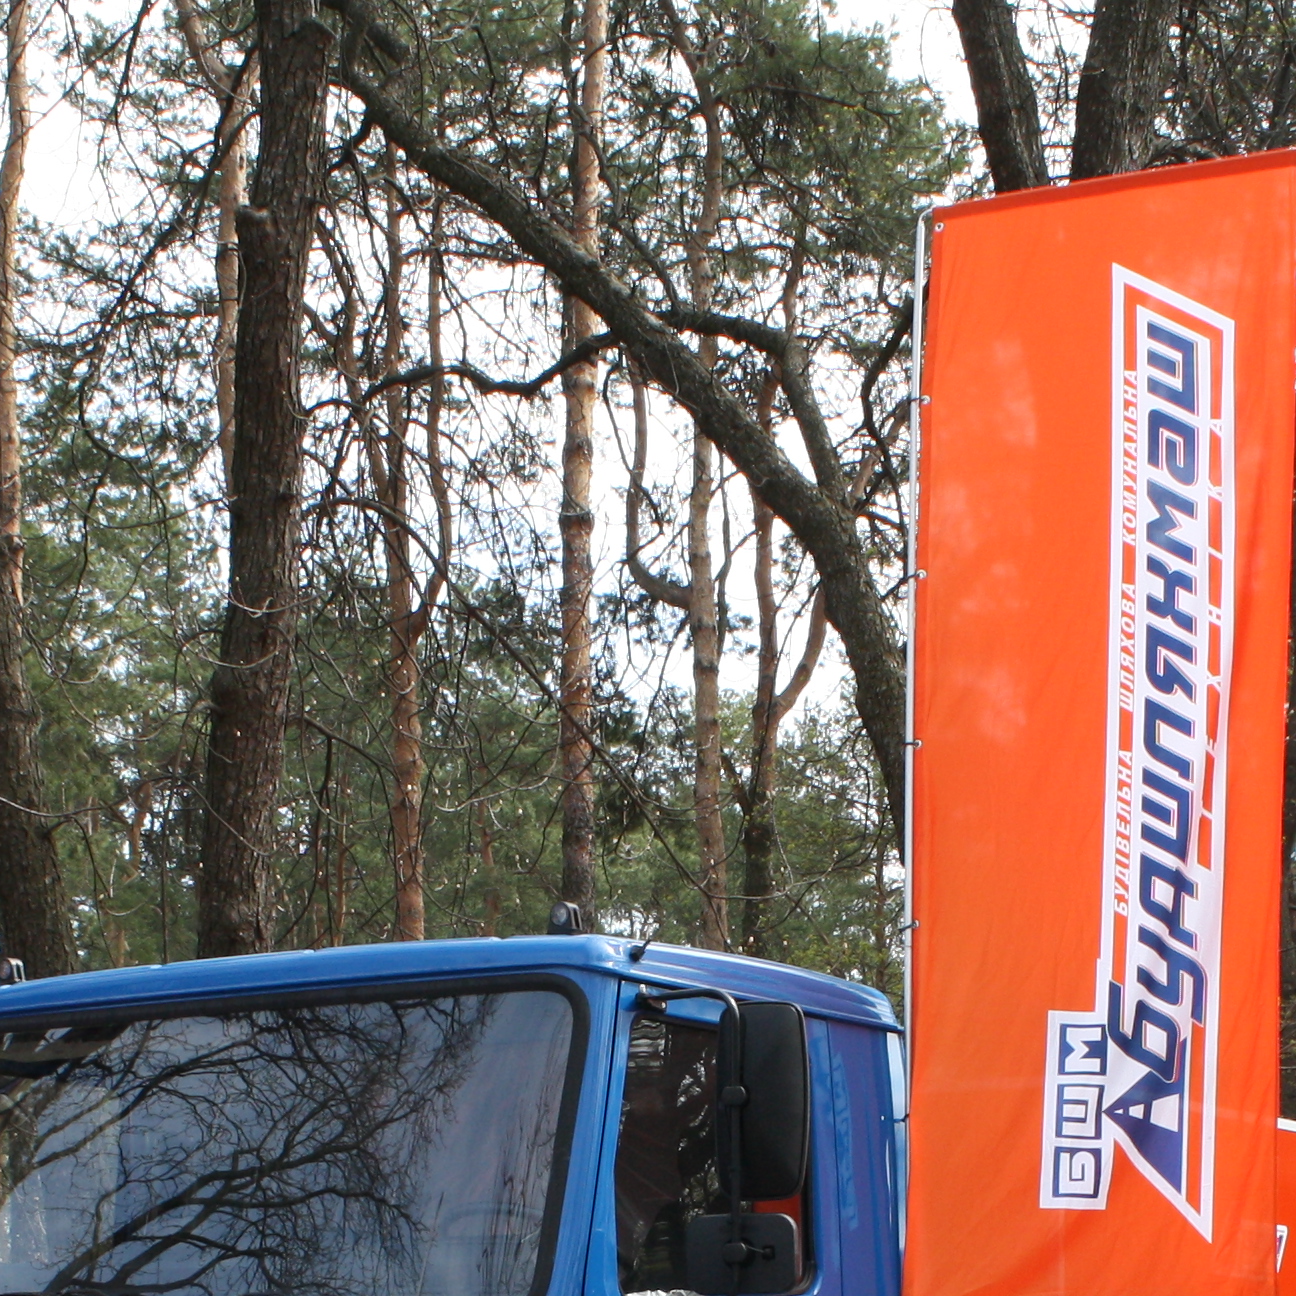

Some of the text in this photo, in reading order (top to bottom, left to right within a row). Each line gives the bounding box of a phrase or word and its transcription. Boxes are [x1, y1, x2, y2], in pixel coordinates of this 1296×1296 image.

[1113, 369, 1138, 917] БУДІВЕЛЬНА ШЛЯХОВА КОМУНАЛЬНА
[1055, 1025, 1105, 1197] БШМ
